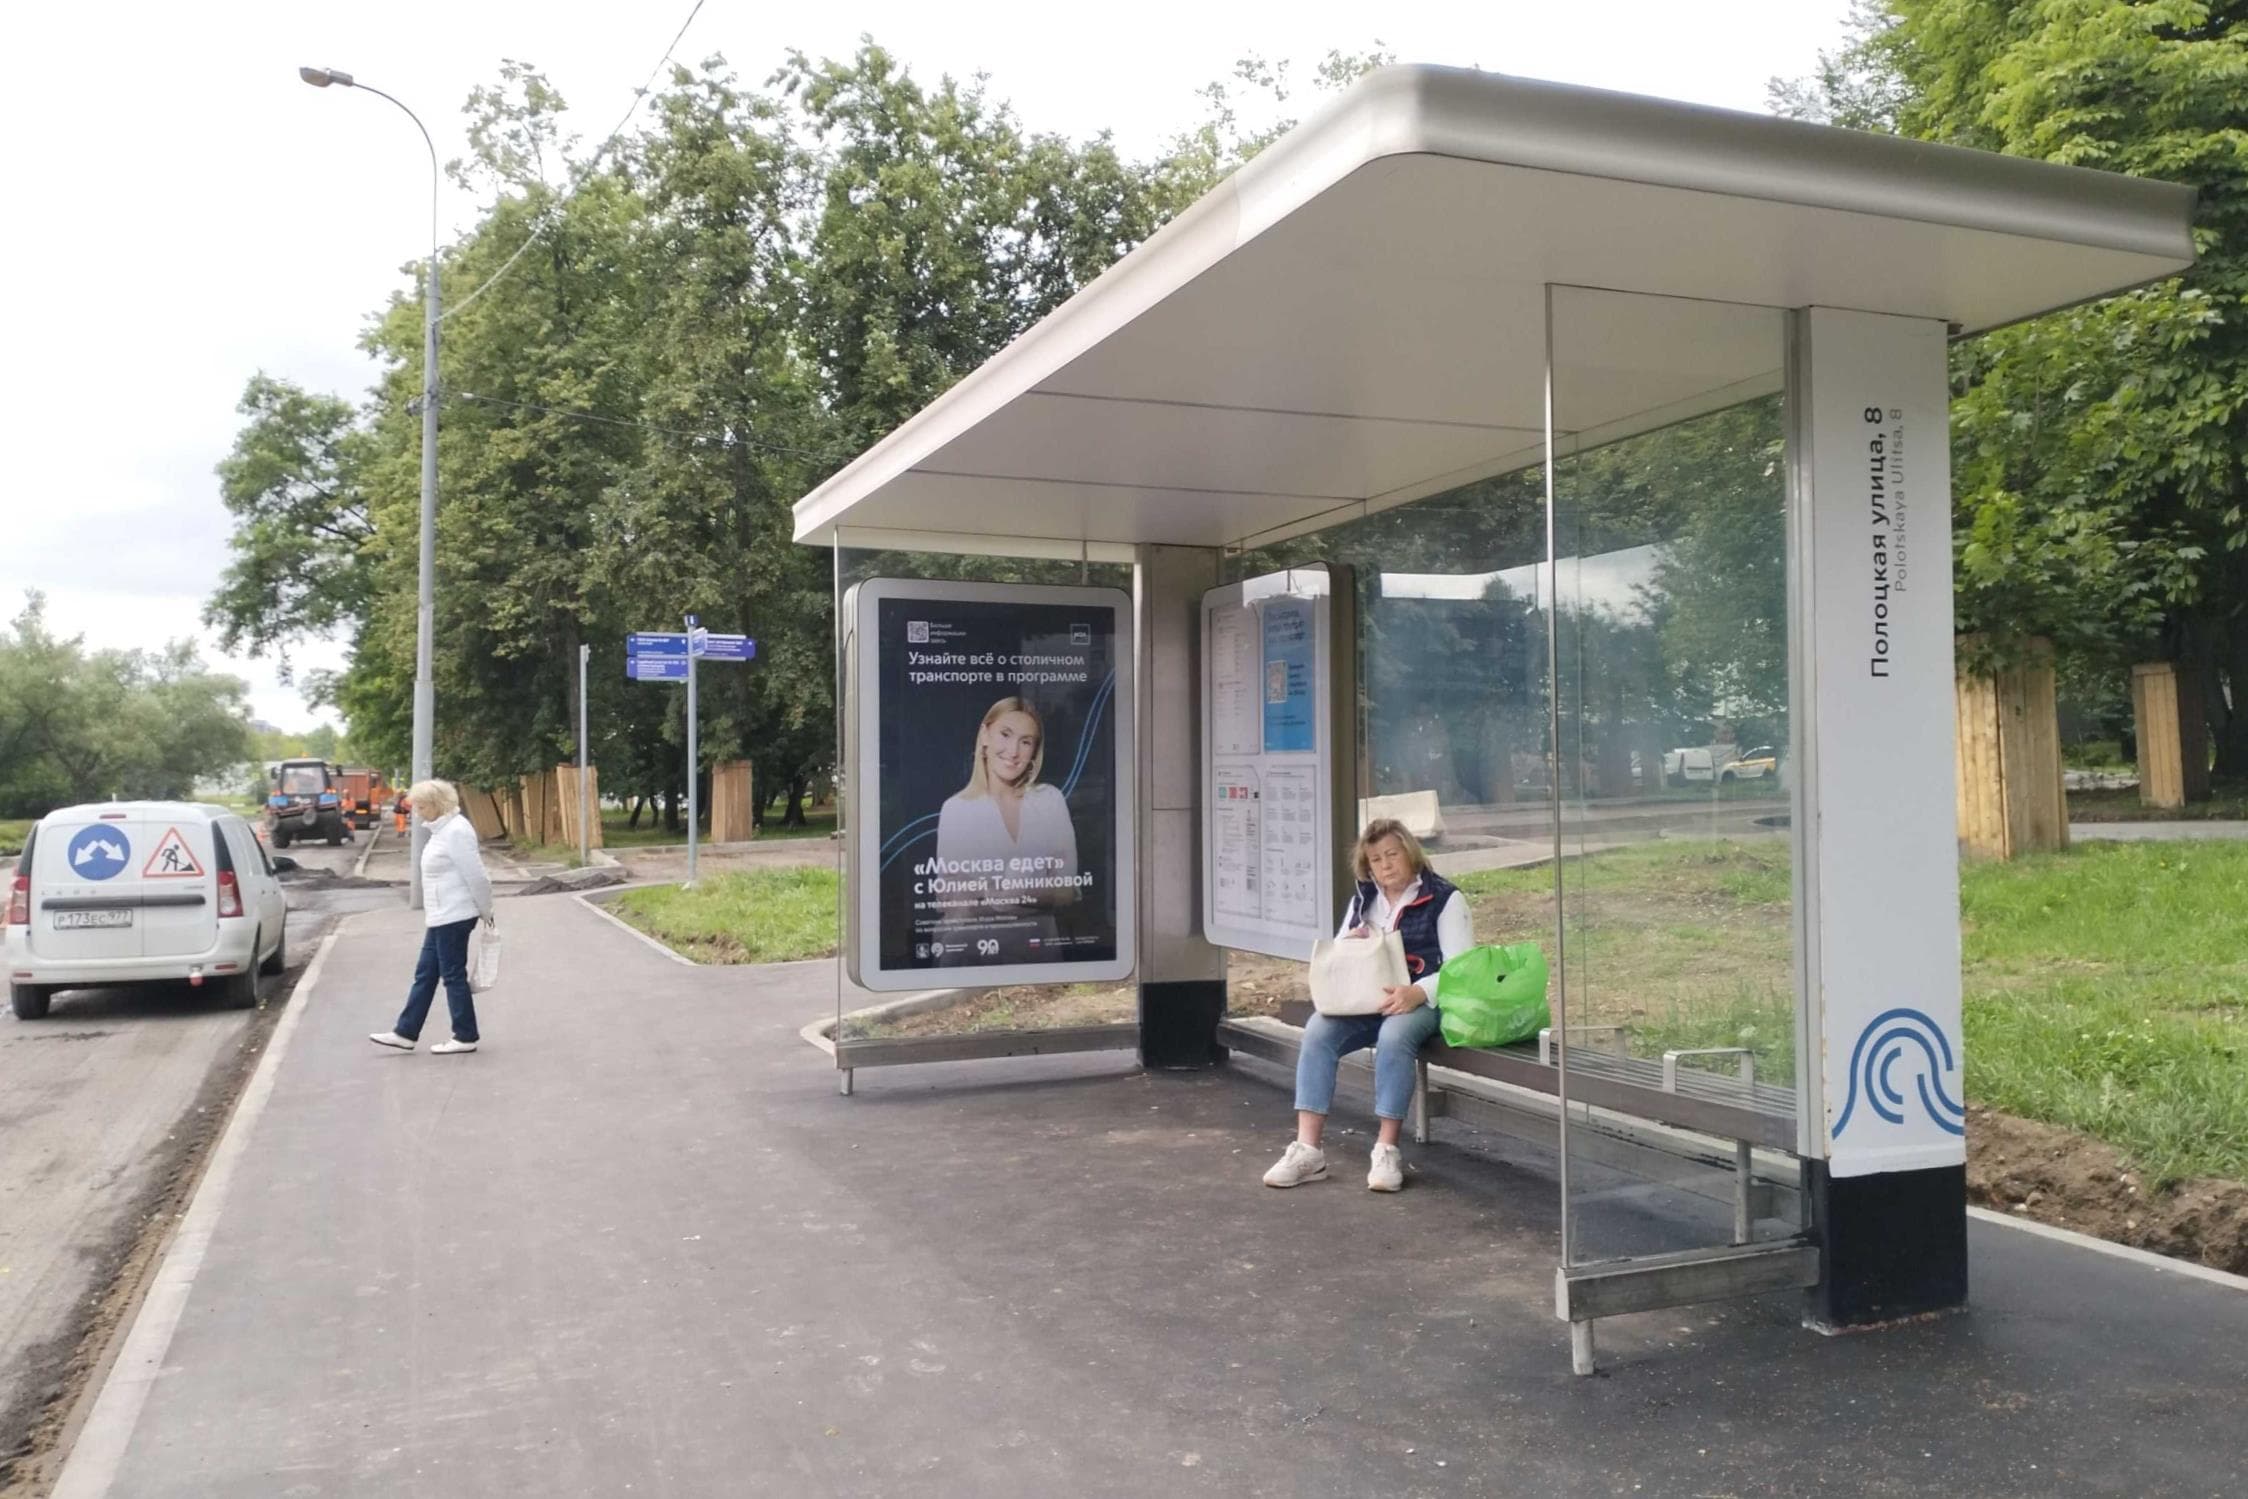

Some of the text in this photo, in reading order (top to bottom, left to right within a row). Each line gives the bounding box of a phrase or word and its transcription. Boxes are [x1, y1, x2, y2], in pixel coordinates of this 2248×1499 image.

[1889, 408, 1907, 592] Polotskaya Ulitsa, 8
[1864, 407, 1890, 677] Полоцкая улица, 8
[908, 651, 1085, 666] Узнайте всё о столичном
[908, 671, 1088, 685] транспорте в программе
[914, 857, 1064, 876] «Москва едет»
[914, 872, 1093, 894] с Юлией Темниковой
